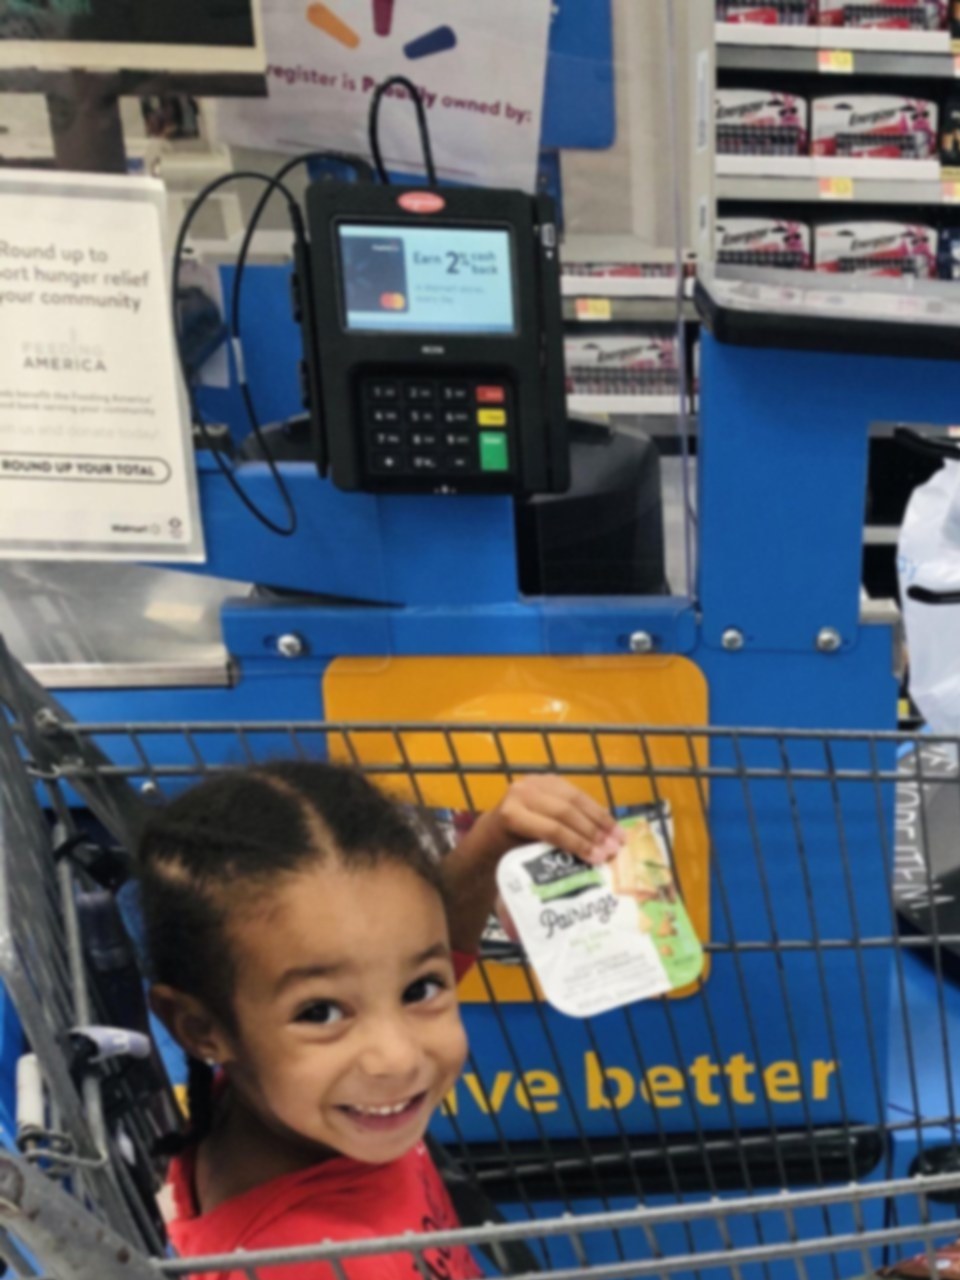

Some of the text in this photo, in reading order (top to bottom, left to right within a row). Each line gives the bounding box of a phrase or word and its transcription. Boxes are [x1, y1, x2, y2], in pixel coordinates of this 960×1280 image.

[342, 74, 357, 92] is
[442, 92, 501, 116] owned
[61, 248, 85, 265] up
[89, 247, 109, 263] to
[33, 264, 98, 288] hunger
[103, 269, 149, 287] relief
[40, 290, 142, 314] community
[23, 355, 108, 374] AMERICA
[539, 895, 619, 938] Pairings
[584, 1050, 838, 1110] better
